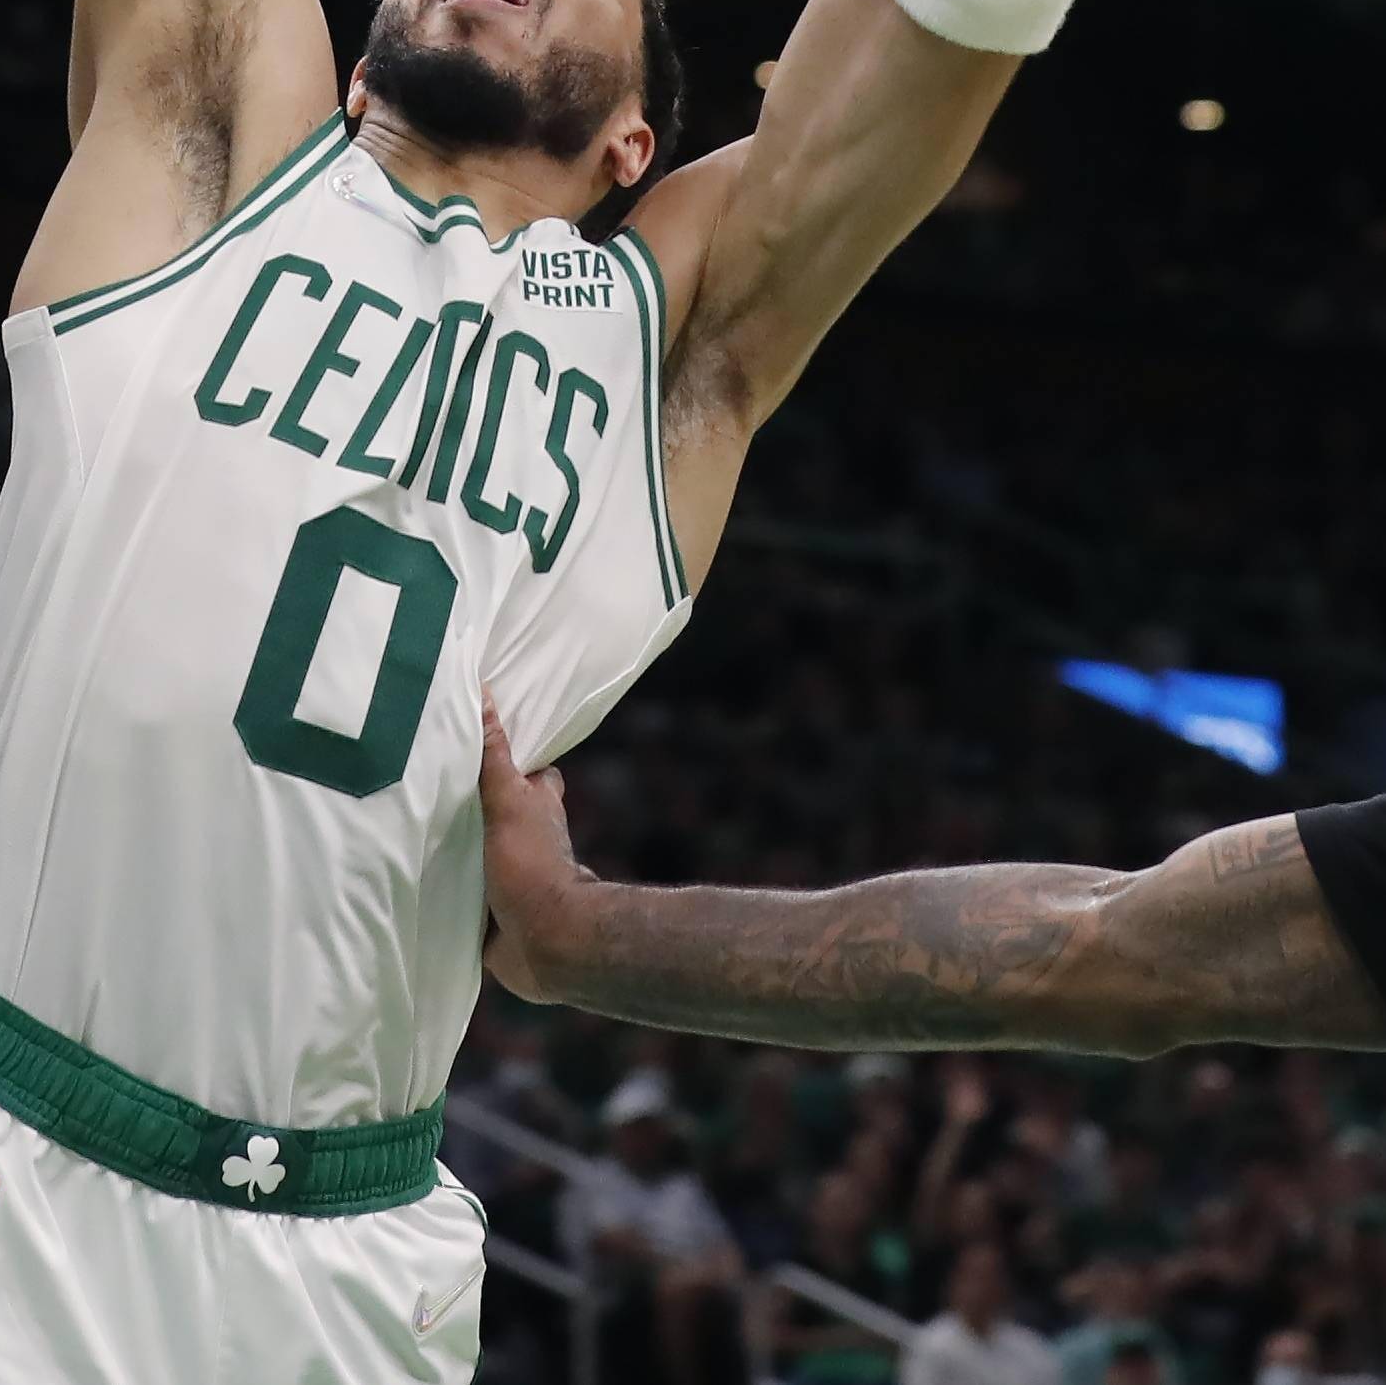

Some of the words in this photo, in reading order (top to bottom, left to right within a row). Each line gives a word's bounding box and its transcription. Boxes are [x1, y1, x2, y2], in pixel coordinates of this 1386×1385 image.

[521, 249, 613, 282] VISTA
[522, 279, 614, 308] PRINT
[194, 252, 609, 574] CELTICS
[232, 504, 460, 799] 0
